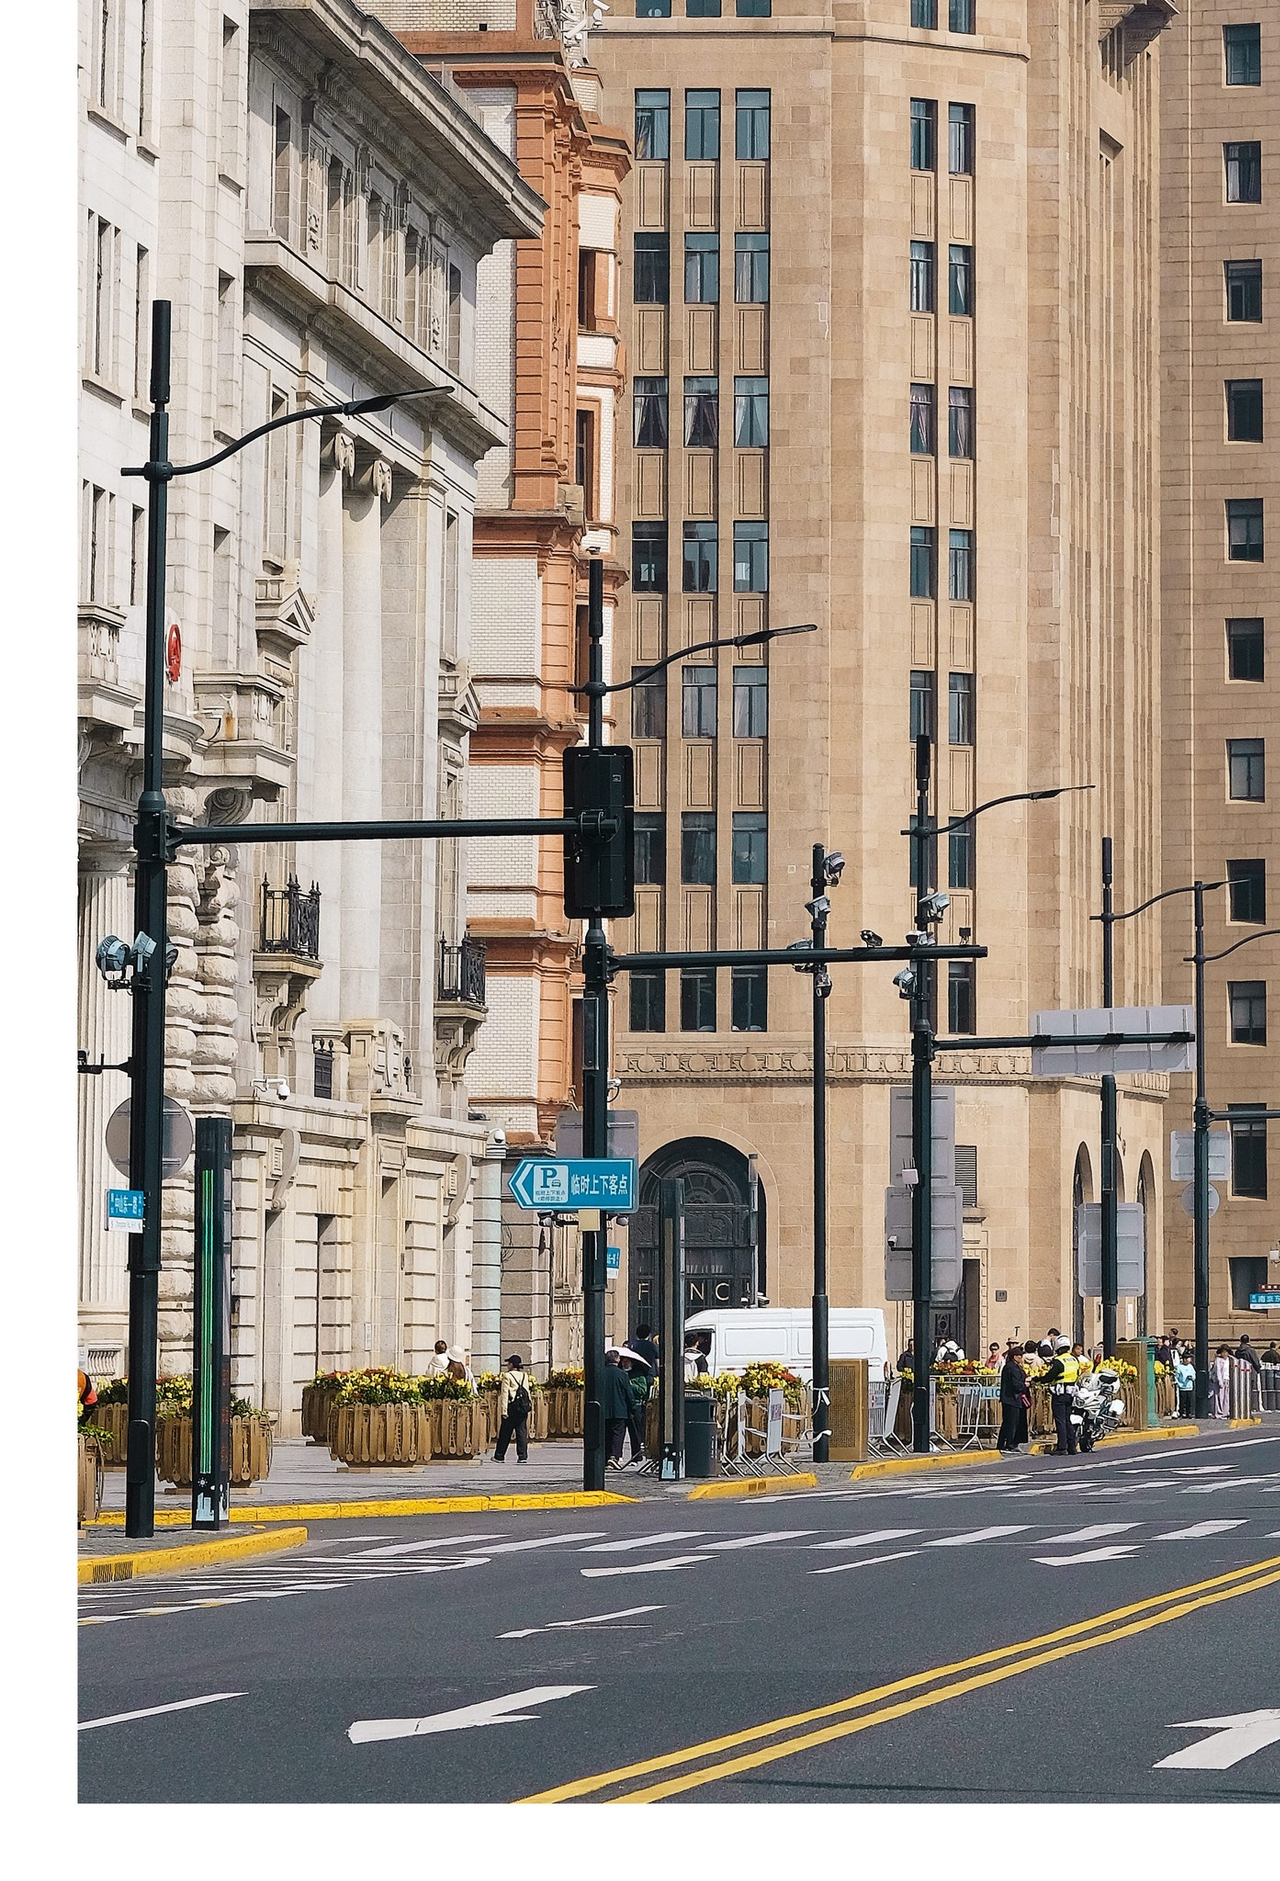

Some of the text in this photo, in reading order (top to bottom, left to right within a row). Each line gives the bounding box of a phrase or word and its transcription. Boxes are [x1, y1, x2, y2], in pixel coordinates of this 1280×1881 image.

[571, 1174, 628, 1195] 临时上下客点
